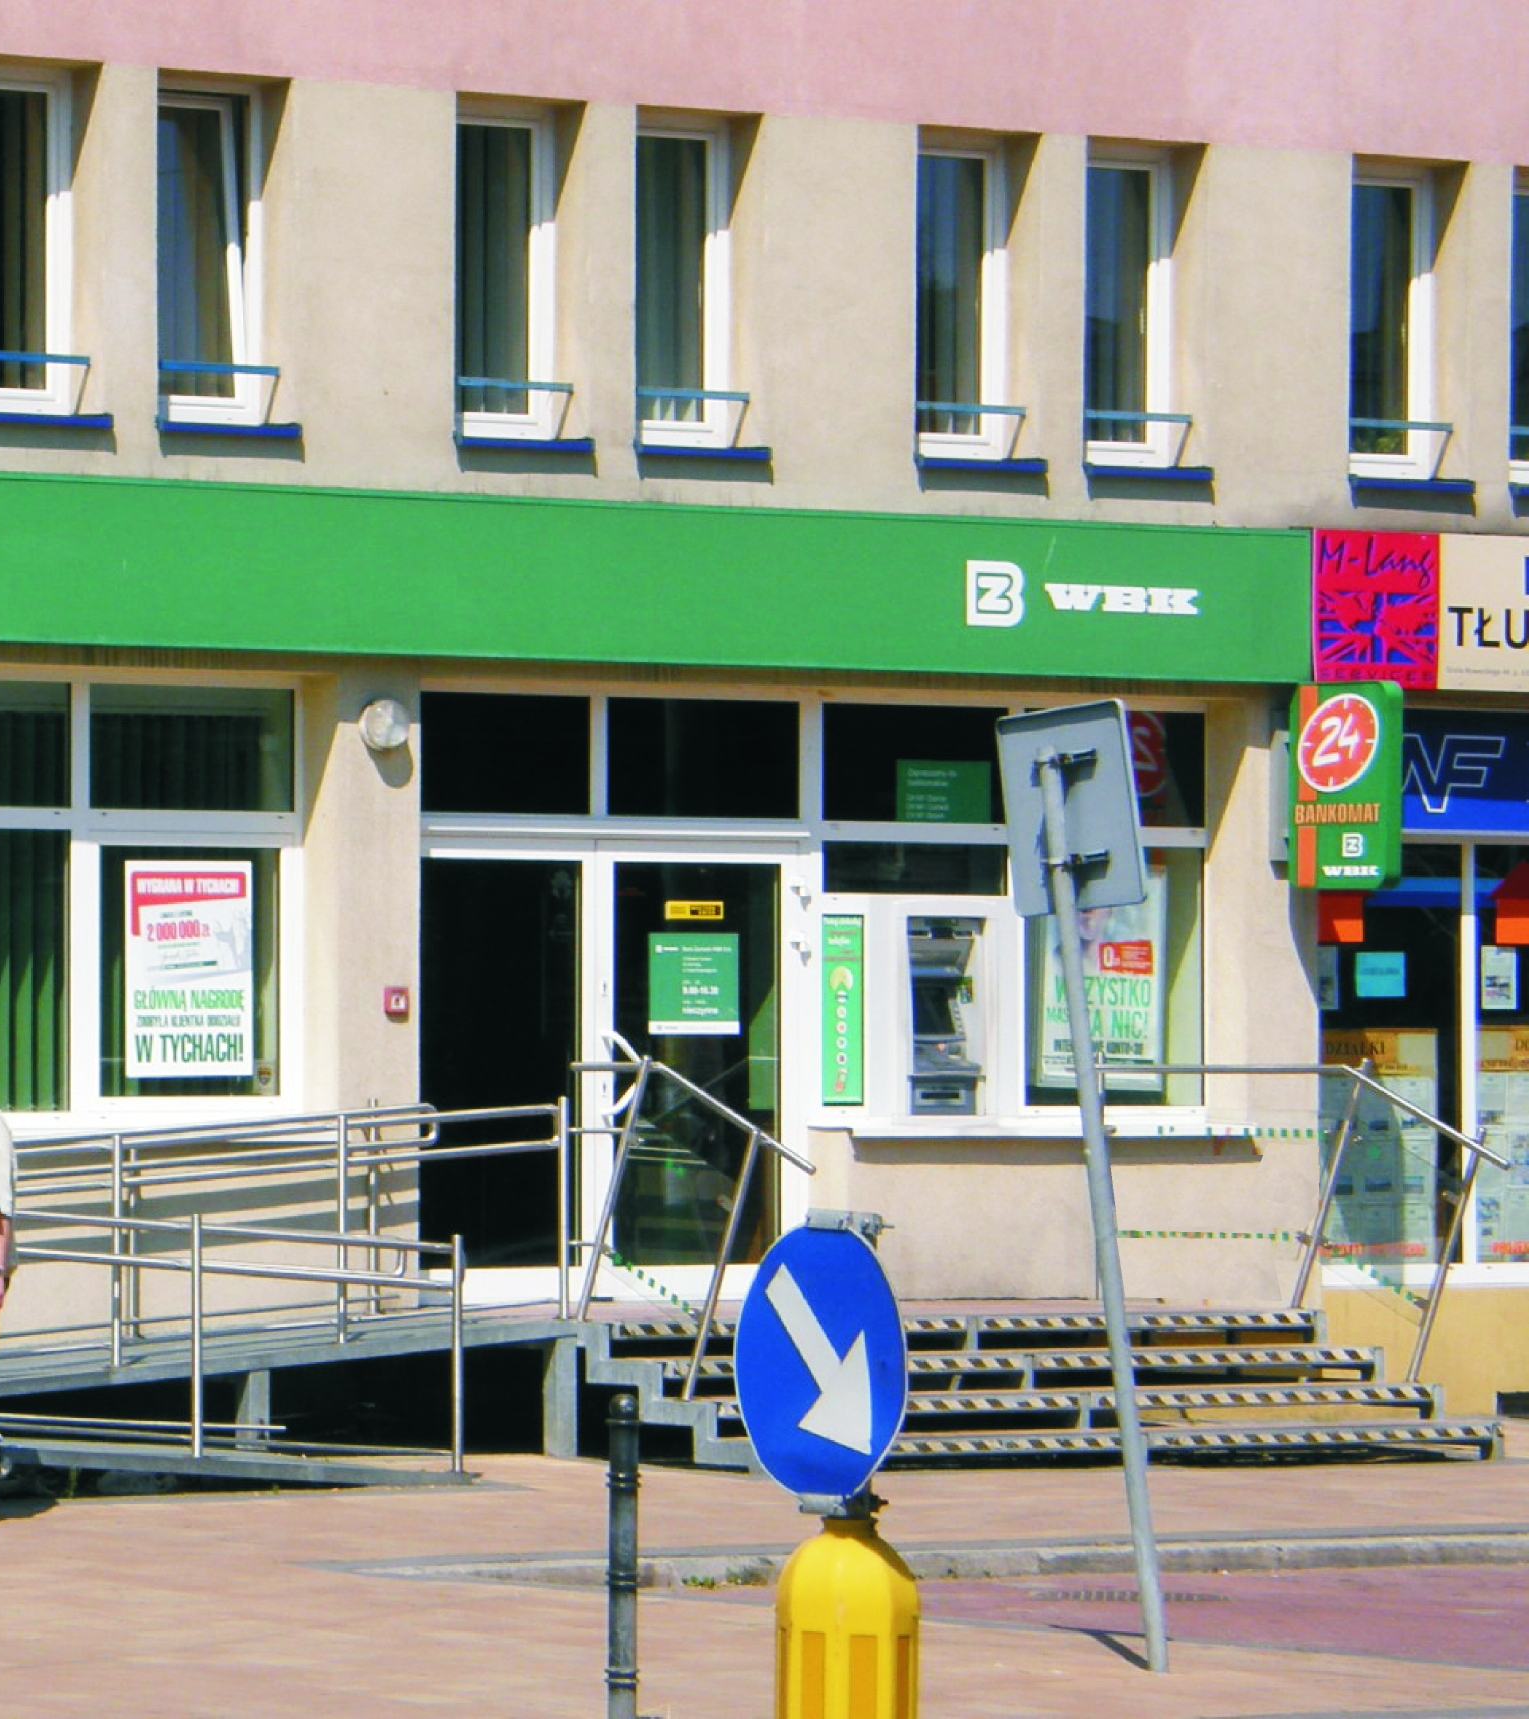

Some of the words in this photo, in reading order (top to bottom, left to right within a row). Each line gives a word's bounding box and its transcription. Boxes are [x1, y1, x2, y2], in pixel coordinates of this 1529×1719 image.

[1319, 536, 1434, 589] M-Lang
[1044, 583, 1200, 615] WBK
[1448, 605, 1529, 649] TŁU
[1312, 713, 1361, 767] 24
[1295, 803, 1379, 824] BANKOMAT
[1323, 865, 1380, 877] WBK
[1110, 1011, 1148, 1039] NIC!
[134, 1033, 153, 1063] W
[160, 1033, 244, 1063] TYCHACH!
